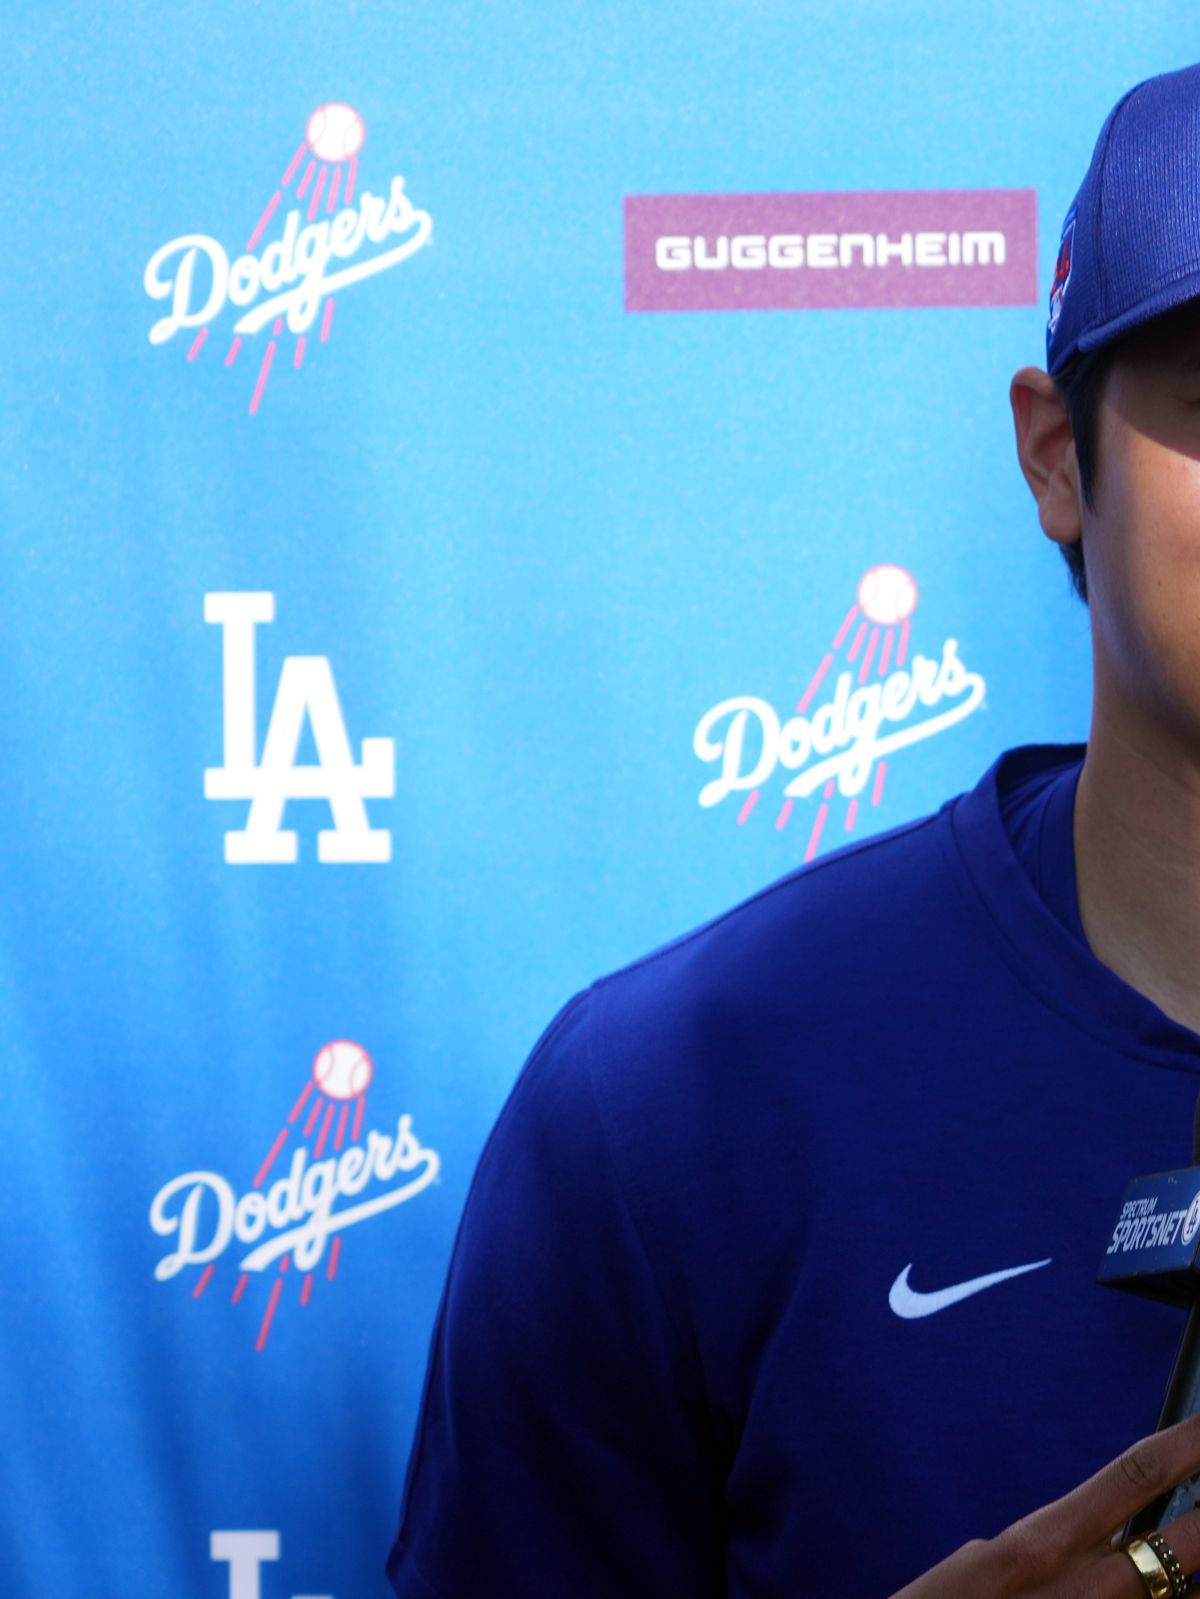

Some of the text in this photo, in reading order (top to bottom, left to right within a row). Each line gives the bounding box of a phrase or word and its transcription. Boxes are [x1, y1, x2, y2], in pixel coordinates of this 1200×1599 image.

[144, 176, 432, 344] Dodgers
[656, 232, 1006, 270] GUGGENHEIM
[204, 592, 395, 864] LA
[694, 639, 985, 807] Dodgers
[150, 1115, 439, 1280] Dodgers
[1106, 1209, 1188, 1254] SPORTSNET
[1119, 1197, 1158, 1219] SPECTRUM
